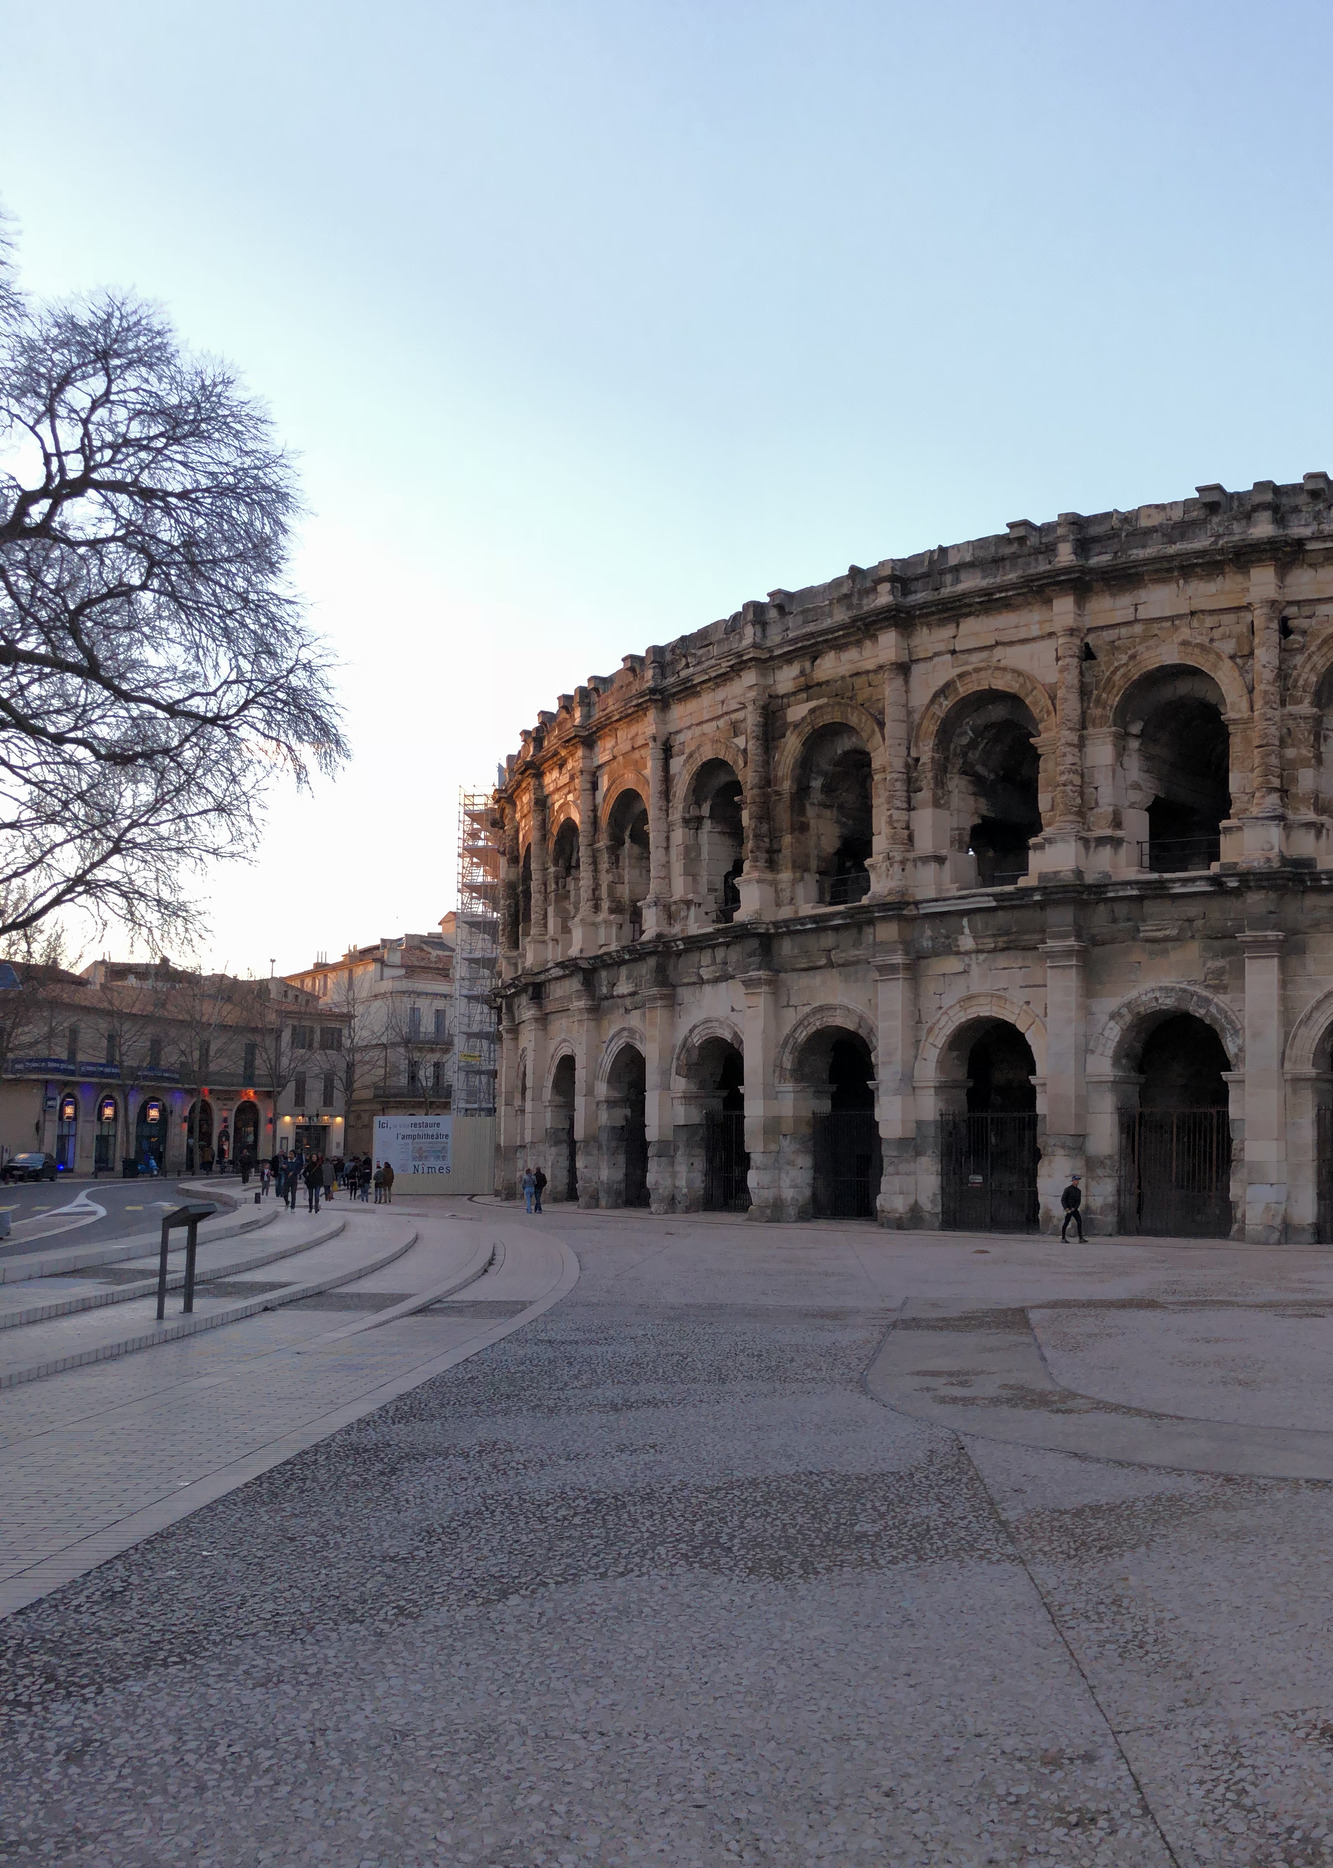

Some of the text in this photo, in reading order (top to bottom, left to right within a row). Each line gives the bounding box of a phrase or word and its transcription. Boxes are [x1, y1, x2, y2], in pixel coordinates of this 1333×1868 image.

[378, 1120, 392, 1130] Ici,
[410, 1121, 441, 1129] restaure
[412, 1163, 451, 1175] Nîmes
